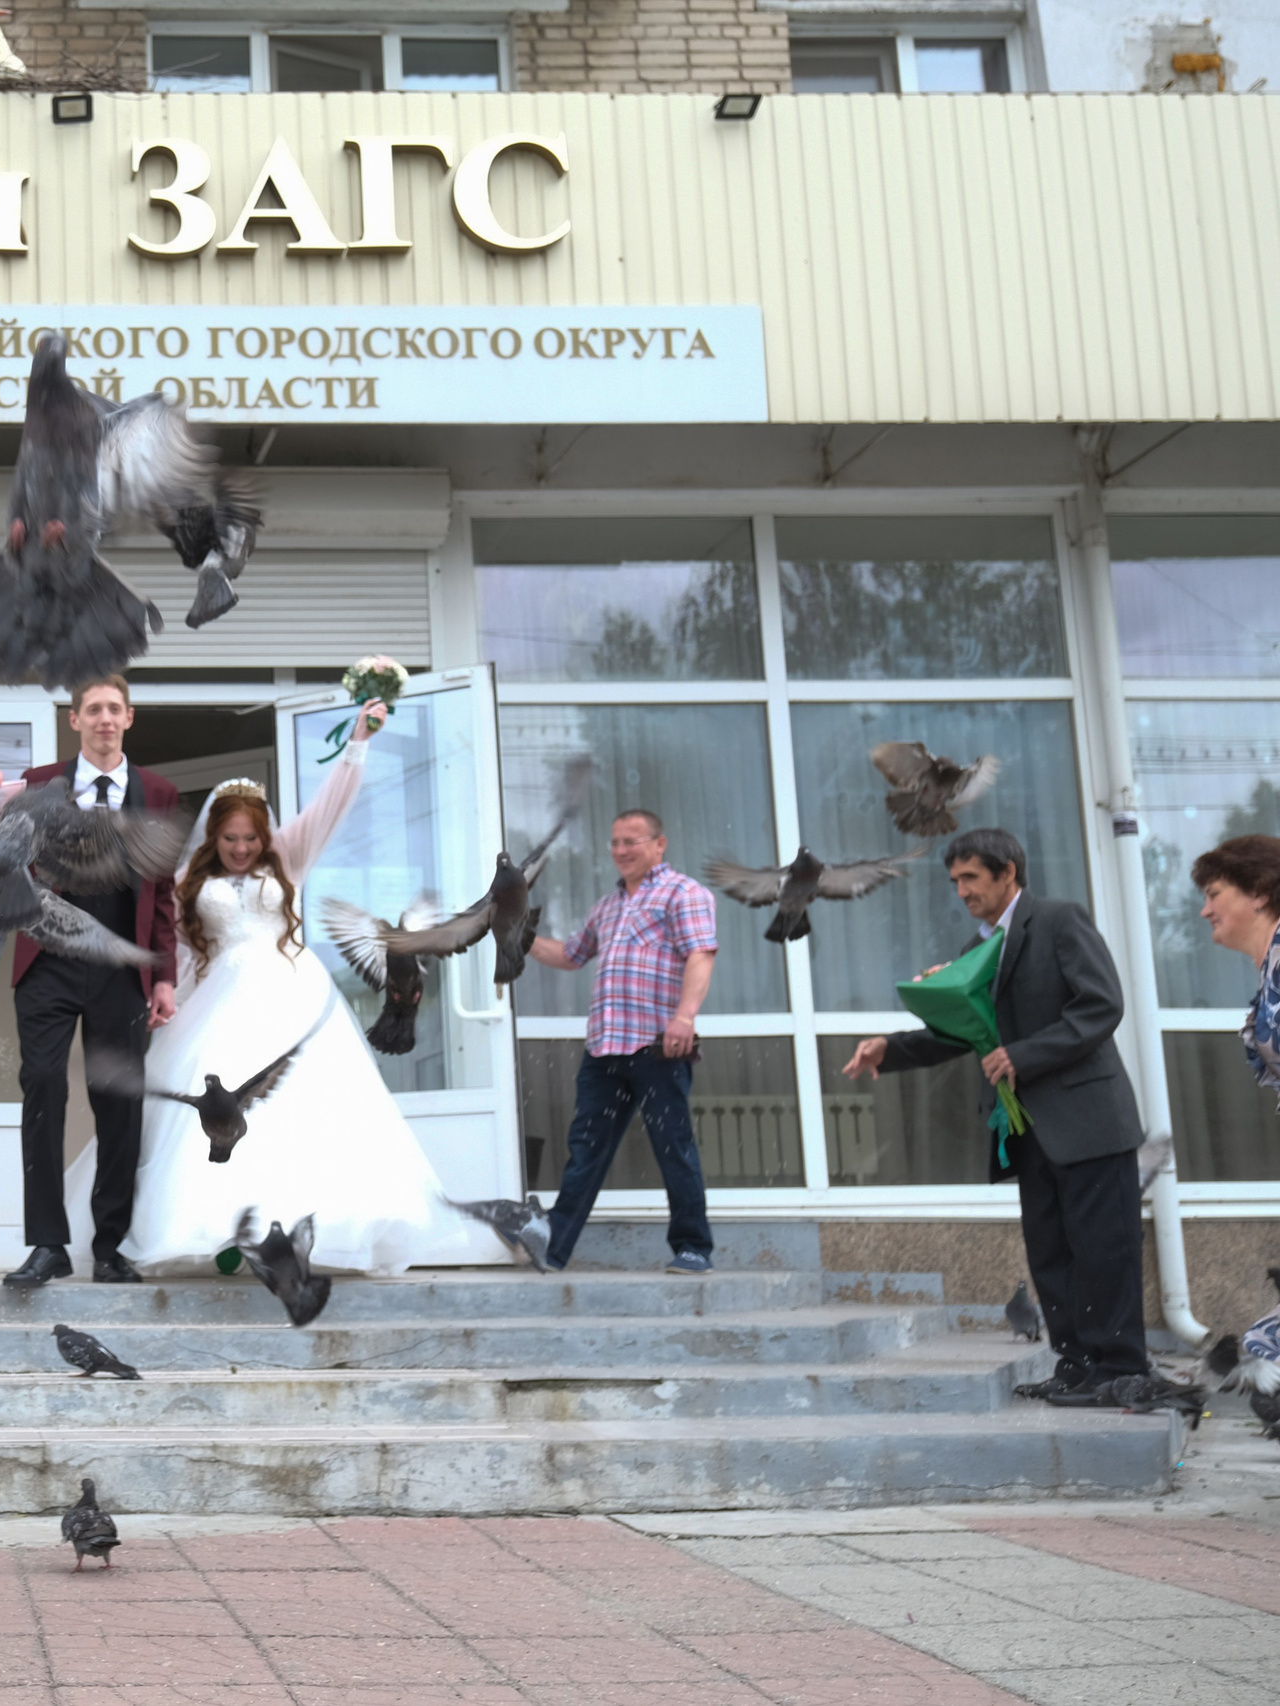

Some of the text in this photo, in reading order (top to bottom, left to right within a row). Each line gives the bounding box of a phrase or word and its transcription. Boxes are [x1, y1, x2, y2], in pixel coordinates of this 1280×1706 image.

[128, 131, 571, 260] ЗАГС
[207, 327, 522, 364] ГОРОДСКОГО
[533, 327, 716, 360] ОКРУГА
[154, 376, 379, 409] ОБЛАСТИ
